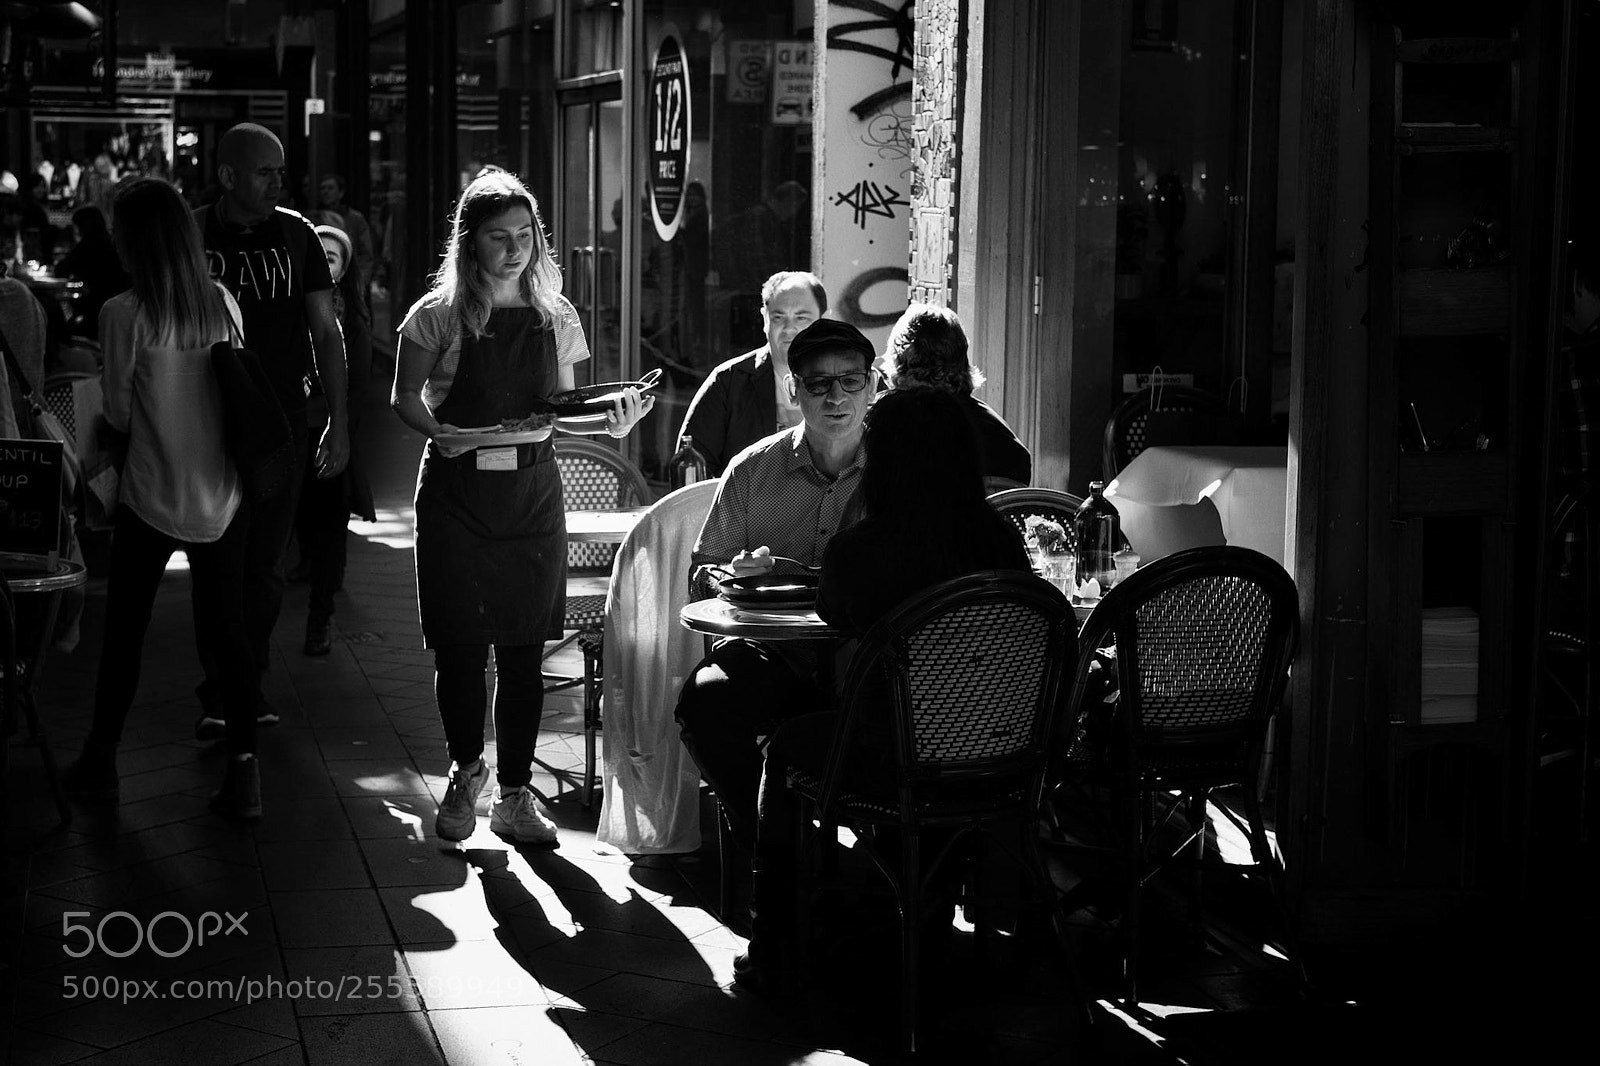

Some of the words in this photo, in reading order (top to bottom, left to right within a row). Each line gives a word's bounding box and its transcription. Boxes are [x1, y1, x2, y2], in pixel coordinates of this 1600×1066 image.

[655, 78, 682, 153] 1/2
[658, 160, 677, 179] PRICE
[0, 448, 53, 465] NTIL
[0, 474, 29, 489] UP
